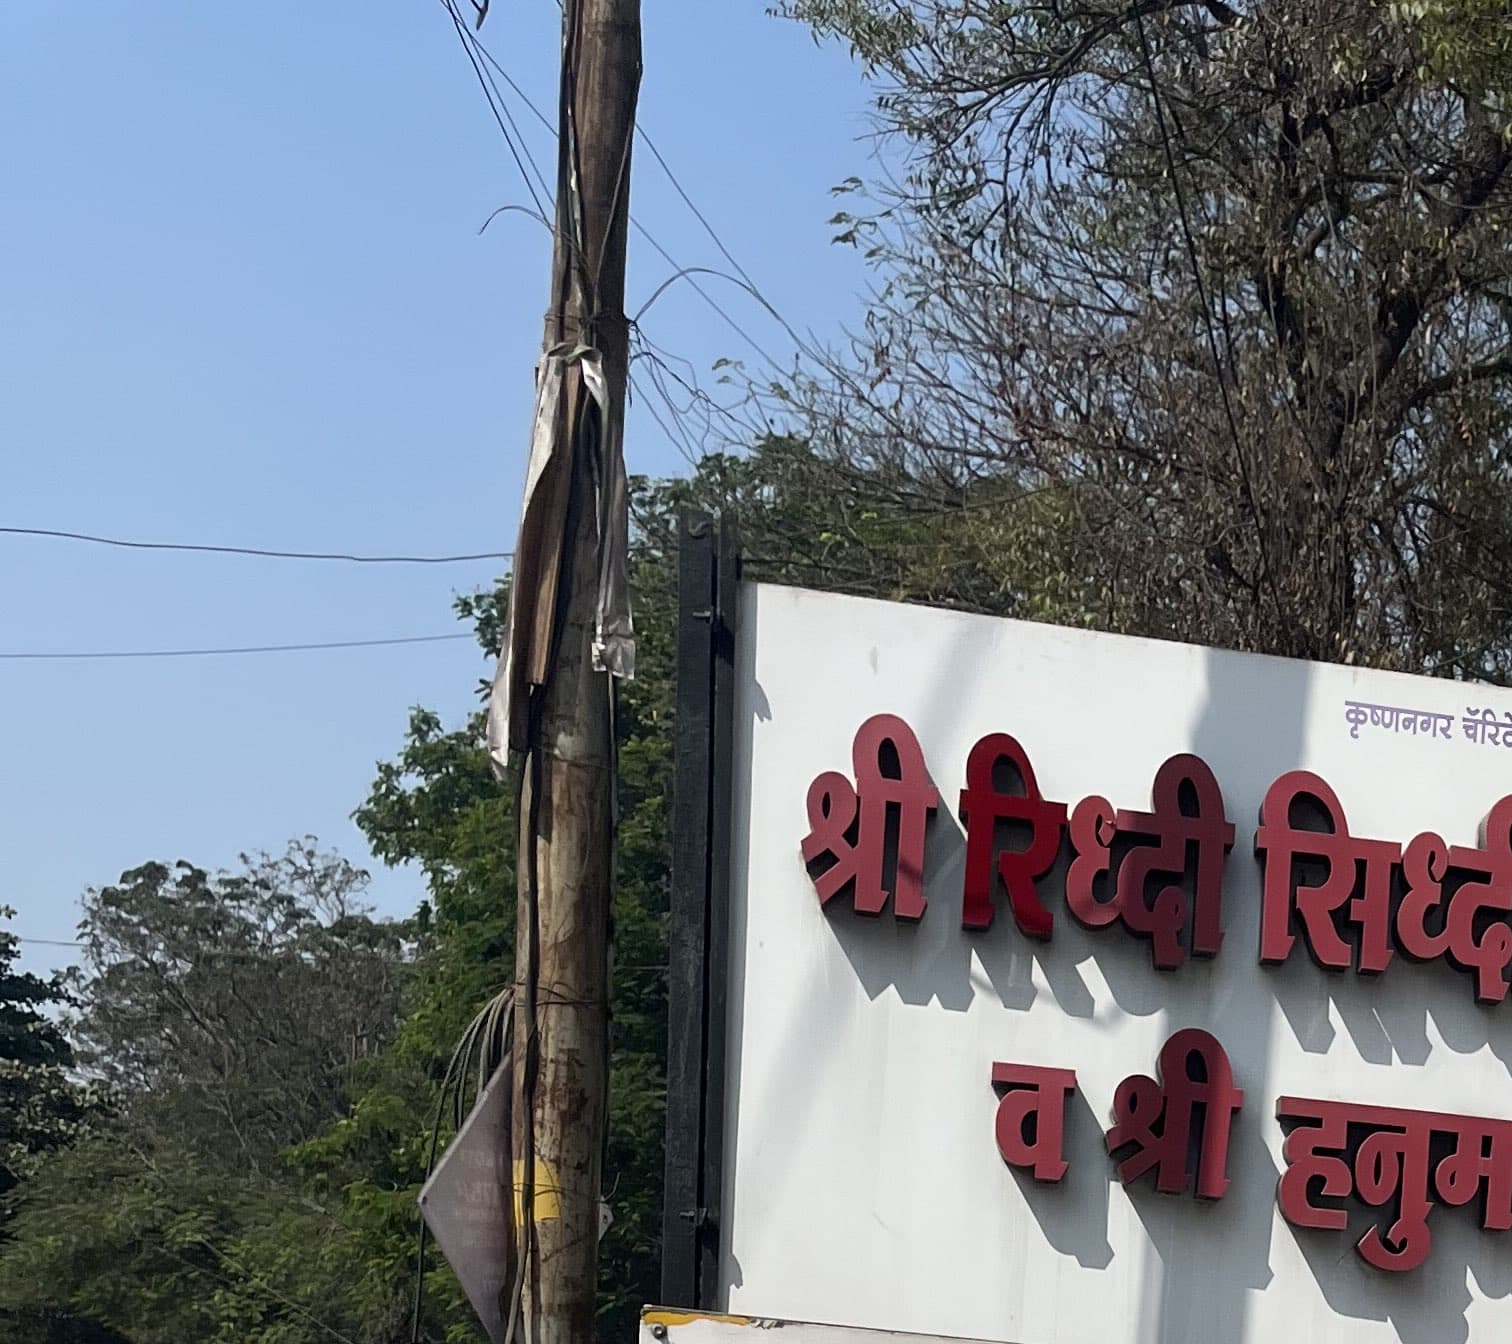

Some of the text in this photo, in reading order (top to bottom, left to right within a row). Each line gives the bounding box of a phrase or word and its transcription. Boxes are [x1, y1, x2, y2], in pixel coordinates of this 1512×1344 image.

[1344, 700, 1455, 740] कृष्णनगर
[801, 713, 939, 922] श्री
[991, 1061, 1077, 1183] व
[1104, 1027, 1245, 1200] श्री
